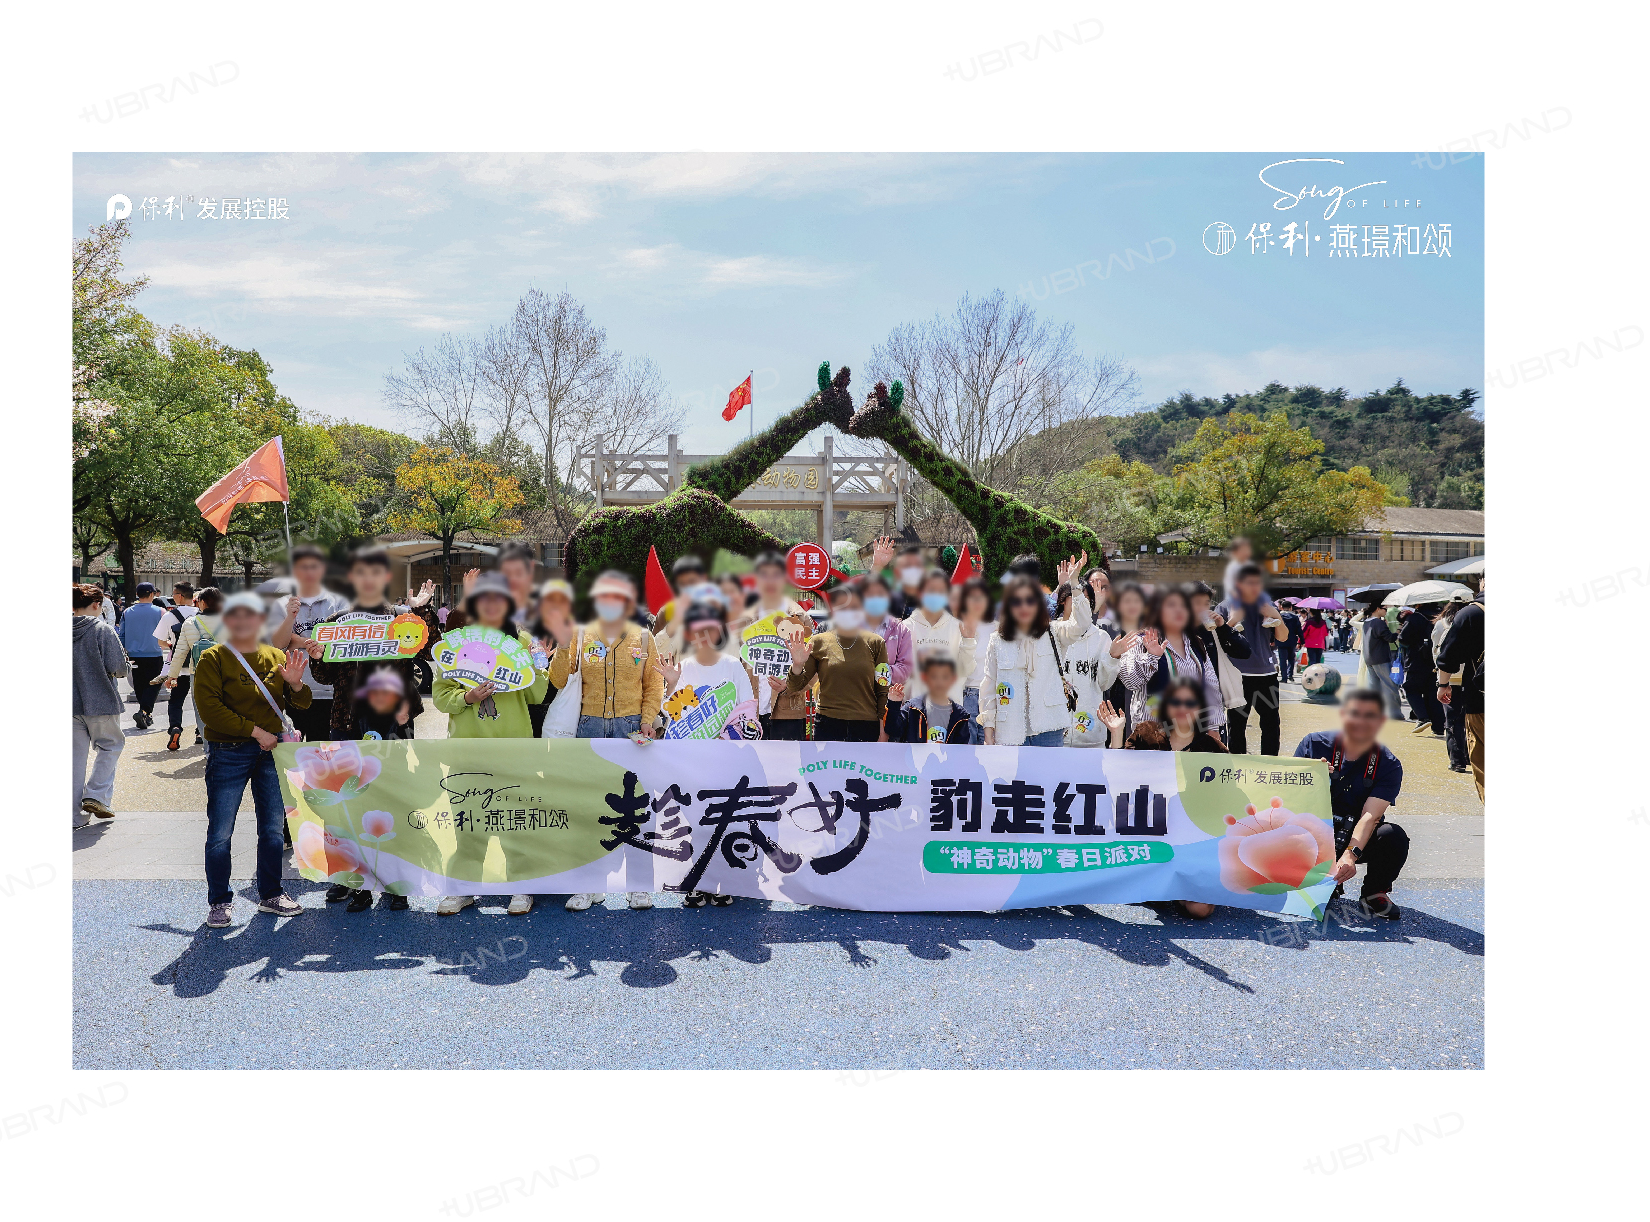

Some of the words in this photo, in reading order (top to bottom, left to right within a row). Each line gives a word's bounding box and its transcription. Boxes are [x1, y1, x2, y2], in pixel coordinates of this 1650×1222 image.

[750, 467, 819, 490] 动物园
[795, 552, 820, 565] 富强
[795, 567, 820, 579] 民主
[1287, 567, 1310, 575] Tourist
[1312, 567, 1334, 575] Centre
[317, 624, 386, 641] 春风有信
[330, 640, 399, 658] 万物有灵
[441, 650, 455, 665] 在
[749, 648, 794, 663] 神奇动
[494, 666, 523, 685] 红山
[798, 760, 829, 777] POLY
[832, 760, 857, 771] LIFE
[859, 764, 918, 785] TOGETHER
[929, 778, 1169, 837] 豹走红山
